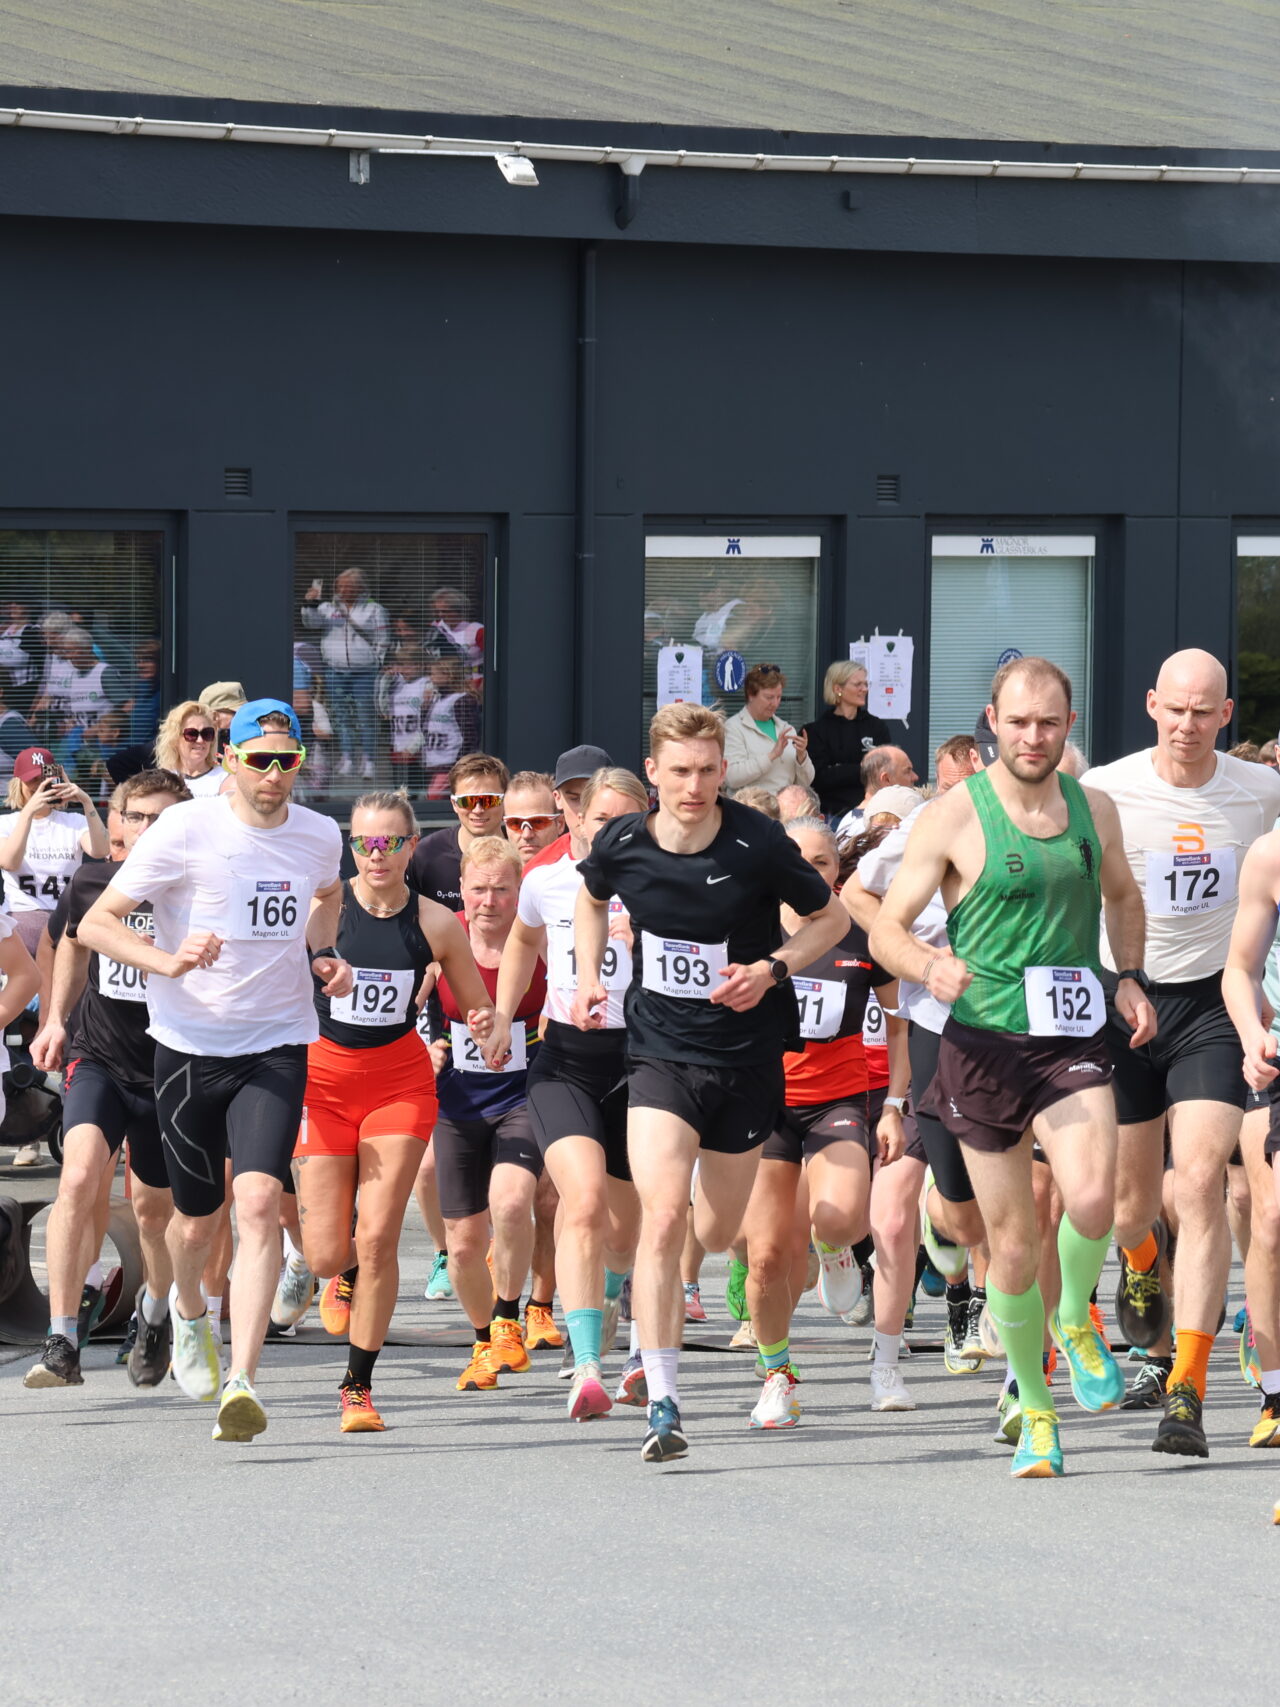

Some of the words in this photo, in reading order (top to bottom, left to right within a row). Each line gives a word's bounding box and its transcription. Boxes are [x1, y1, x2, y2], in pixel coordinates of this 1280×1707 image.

[1164, 867, 1220, 901] 172
[247, 895, 298, 927] 166
[1171, 904, 1200, 913] Magnor
[252, 930, 280, 938] Magnor
[567, 946, 618, 977] 19
[656, 954, 711, 987] 193
[351, 983, 399, 1014] 192
[663, 985, 692, 996] Magnor
[1045, 985, 1092, 1021] 152
[351, 1014, 378, 1023] Magnor
[1055, 1024, 1076, 1033] Magnor
